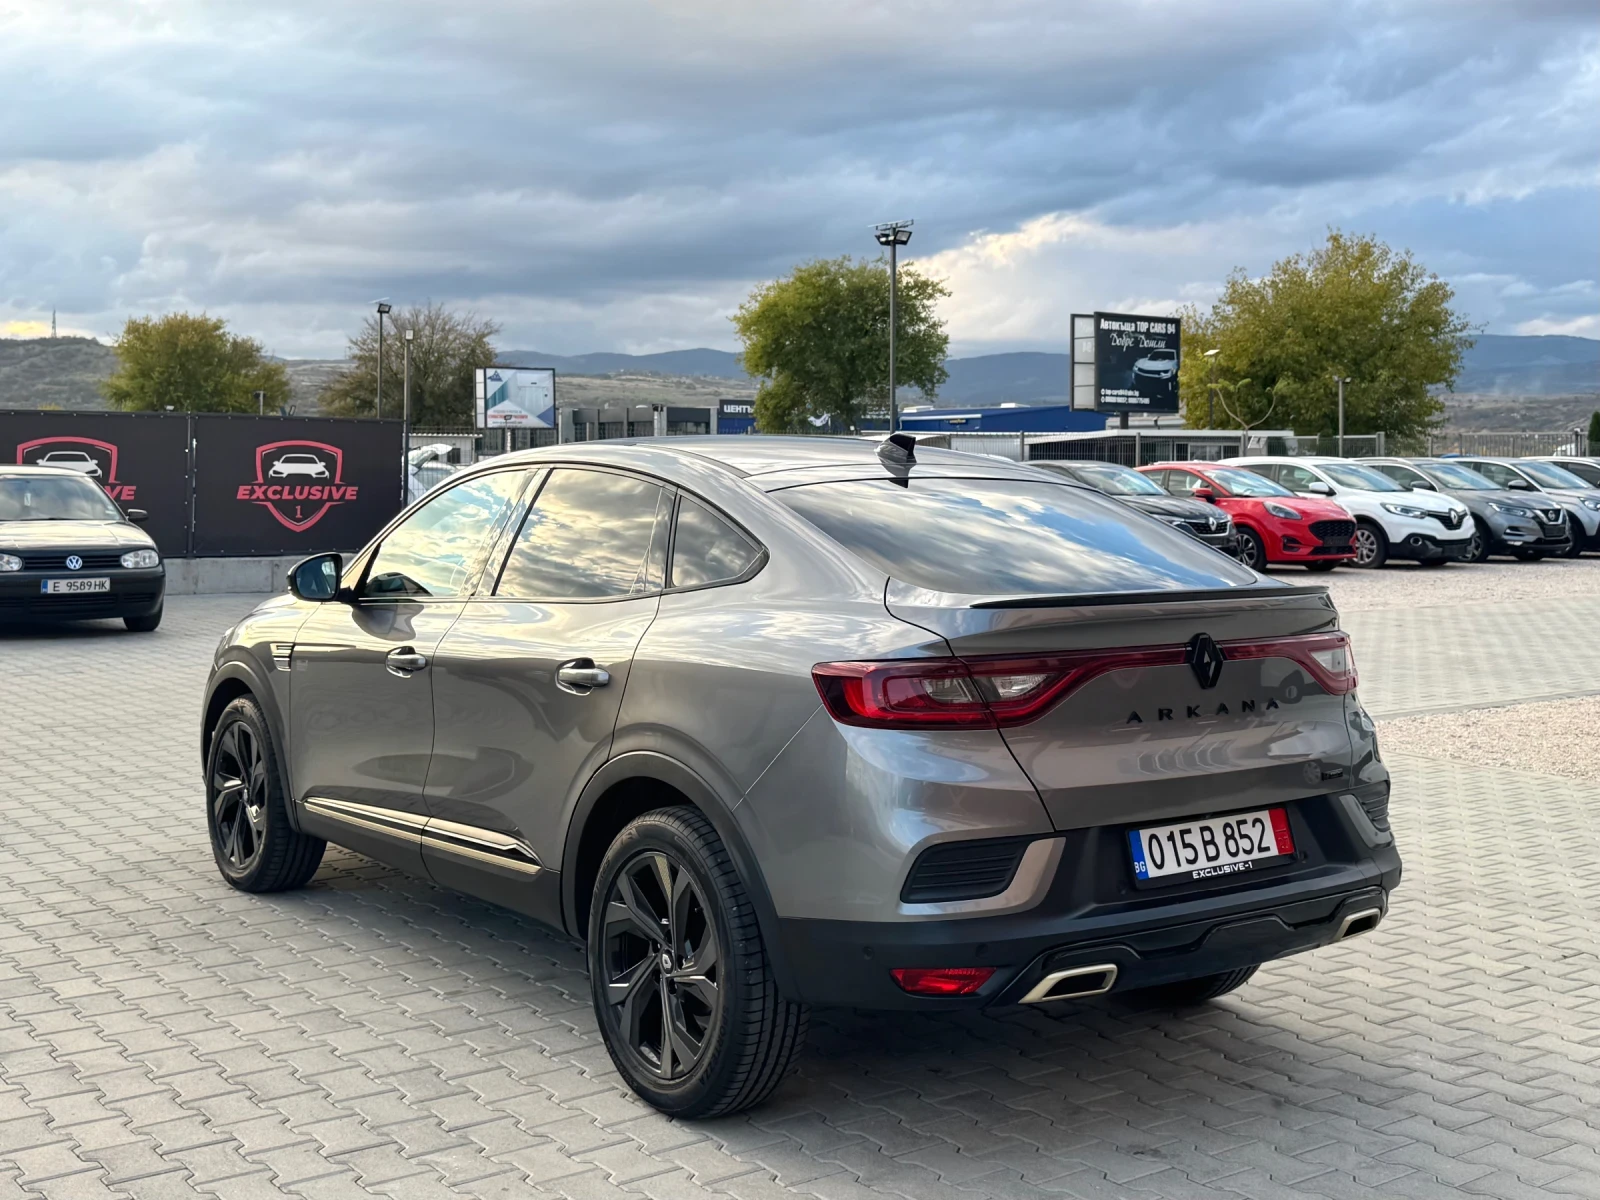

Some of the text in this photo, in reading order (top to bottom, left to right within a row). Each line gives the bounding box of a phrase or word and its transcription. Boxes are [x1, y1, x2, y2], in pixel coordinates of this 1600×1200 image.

[1100, 318, 1175, 335] Автокъща TOP CARS 94
[1109, 331, 1134, 352] Добре
[236, 485, 359, 500] EXCLUSIVE
[295, 505, 303, 519] 1
[53, 581, 60, 592] E
[1126, 698, 1279, 724] ARKANA
[1134, 861, 1147, 873] BG
[1192, 862, 1253, 879] EXCLUSIVE-1
